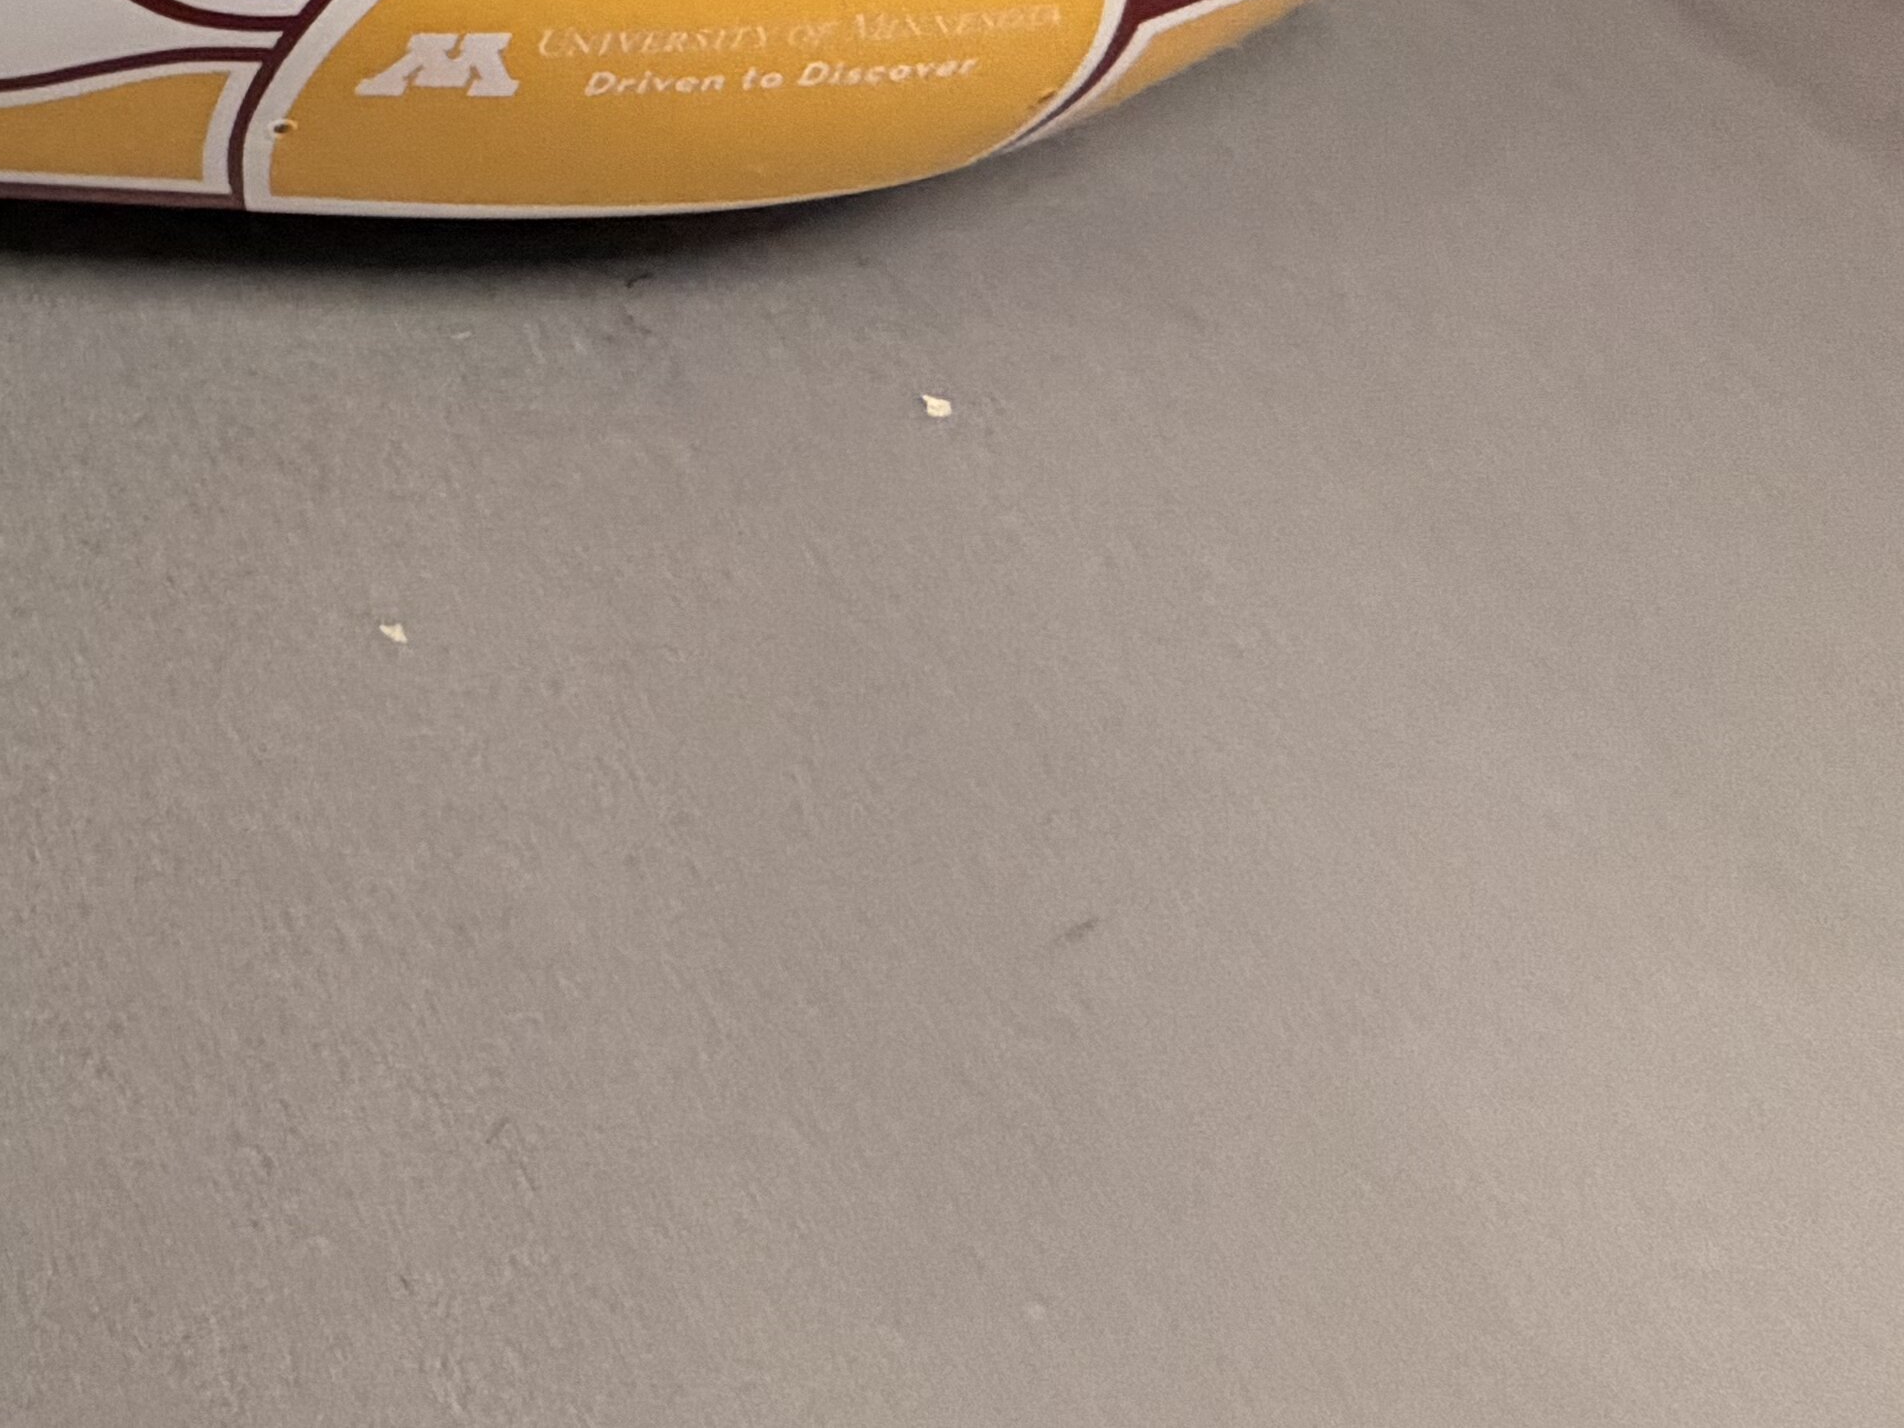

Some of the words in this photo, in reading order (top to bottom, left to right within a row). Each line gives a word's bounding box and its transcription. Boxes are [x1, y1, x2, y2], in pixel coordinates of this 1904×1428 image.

[537, 23, 770, 61] UNIVERSITY
[583, 70, 725, 97] Driven
[741, 64, 784, 90] to
[796, 54, 980, 90] Discover
